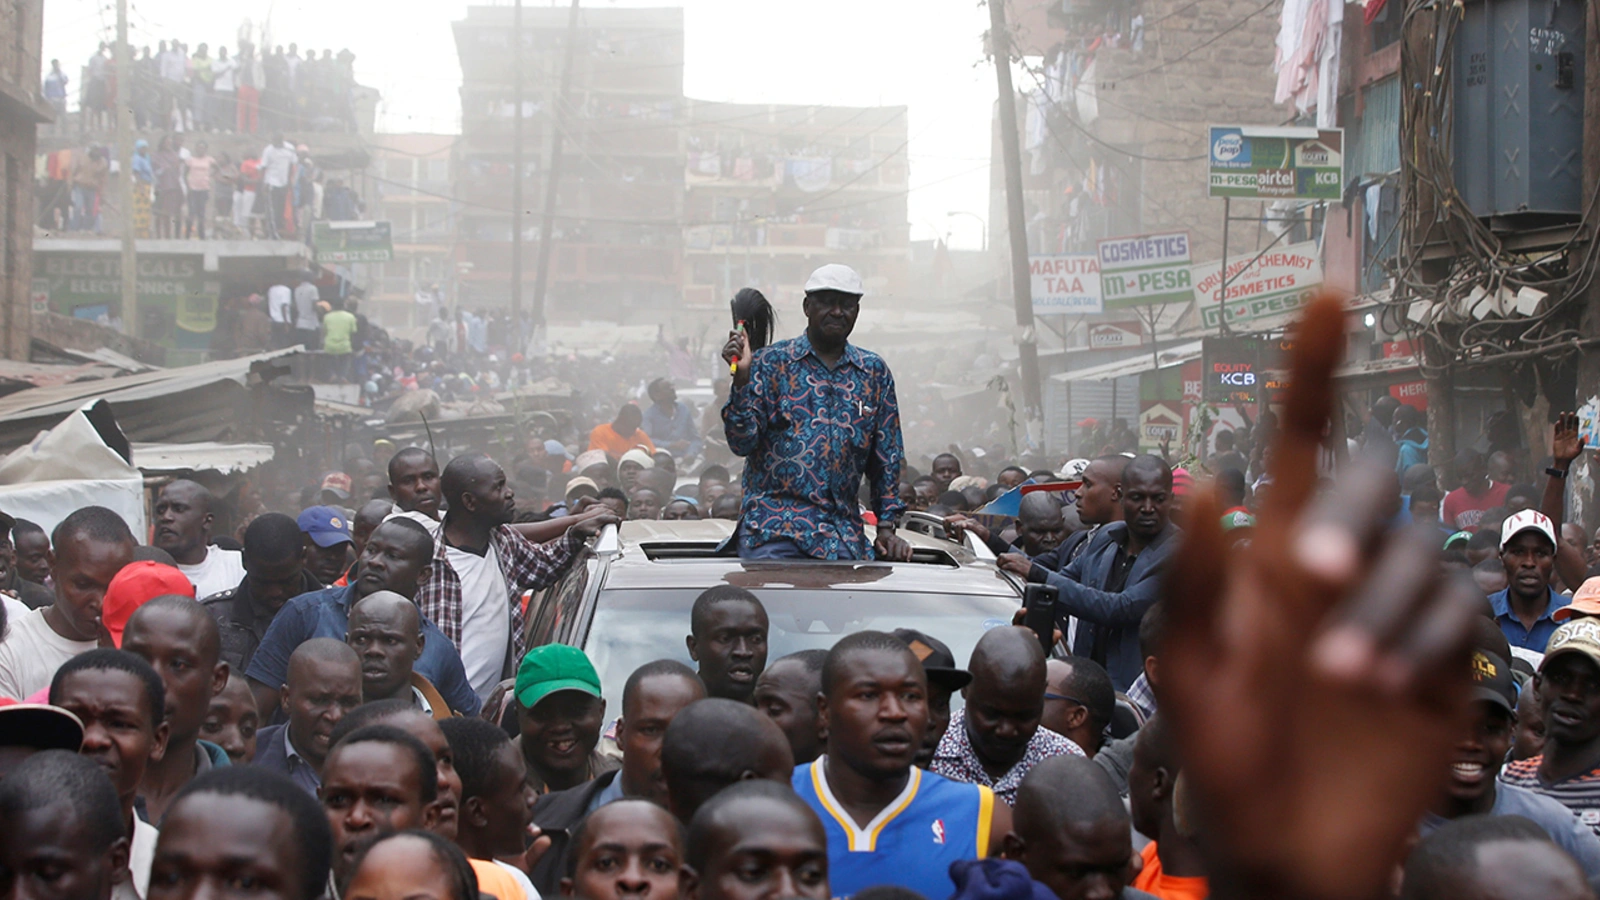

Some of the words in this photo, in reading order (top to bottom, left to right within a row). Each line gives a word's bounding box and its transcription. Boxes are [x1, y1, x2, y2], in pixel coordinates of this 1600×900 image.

[1258, 169, 1294, 185] airtel
[1316, 172, 1338, 184] KCB
[1101, 236, 1187, 263] COSMETICS
[1029, 259, 1100, 276] MAFUTA
[1257, 253, 1315, 271] CHEMIST
[1044, 277, 1085, 294] TAA
[1213, 274, 1296, 303] COSMETICS
[1214, 363, 1252, 372] EQUITY
[1221, 373, 1256, 385] KCB
